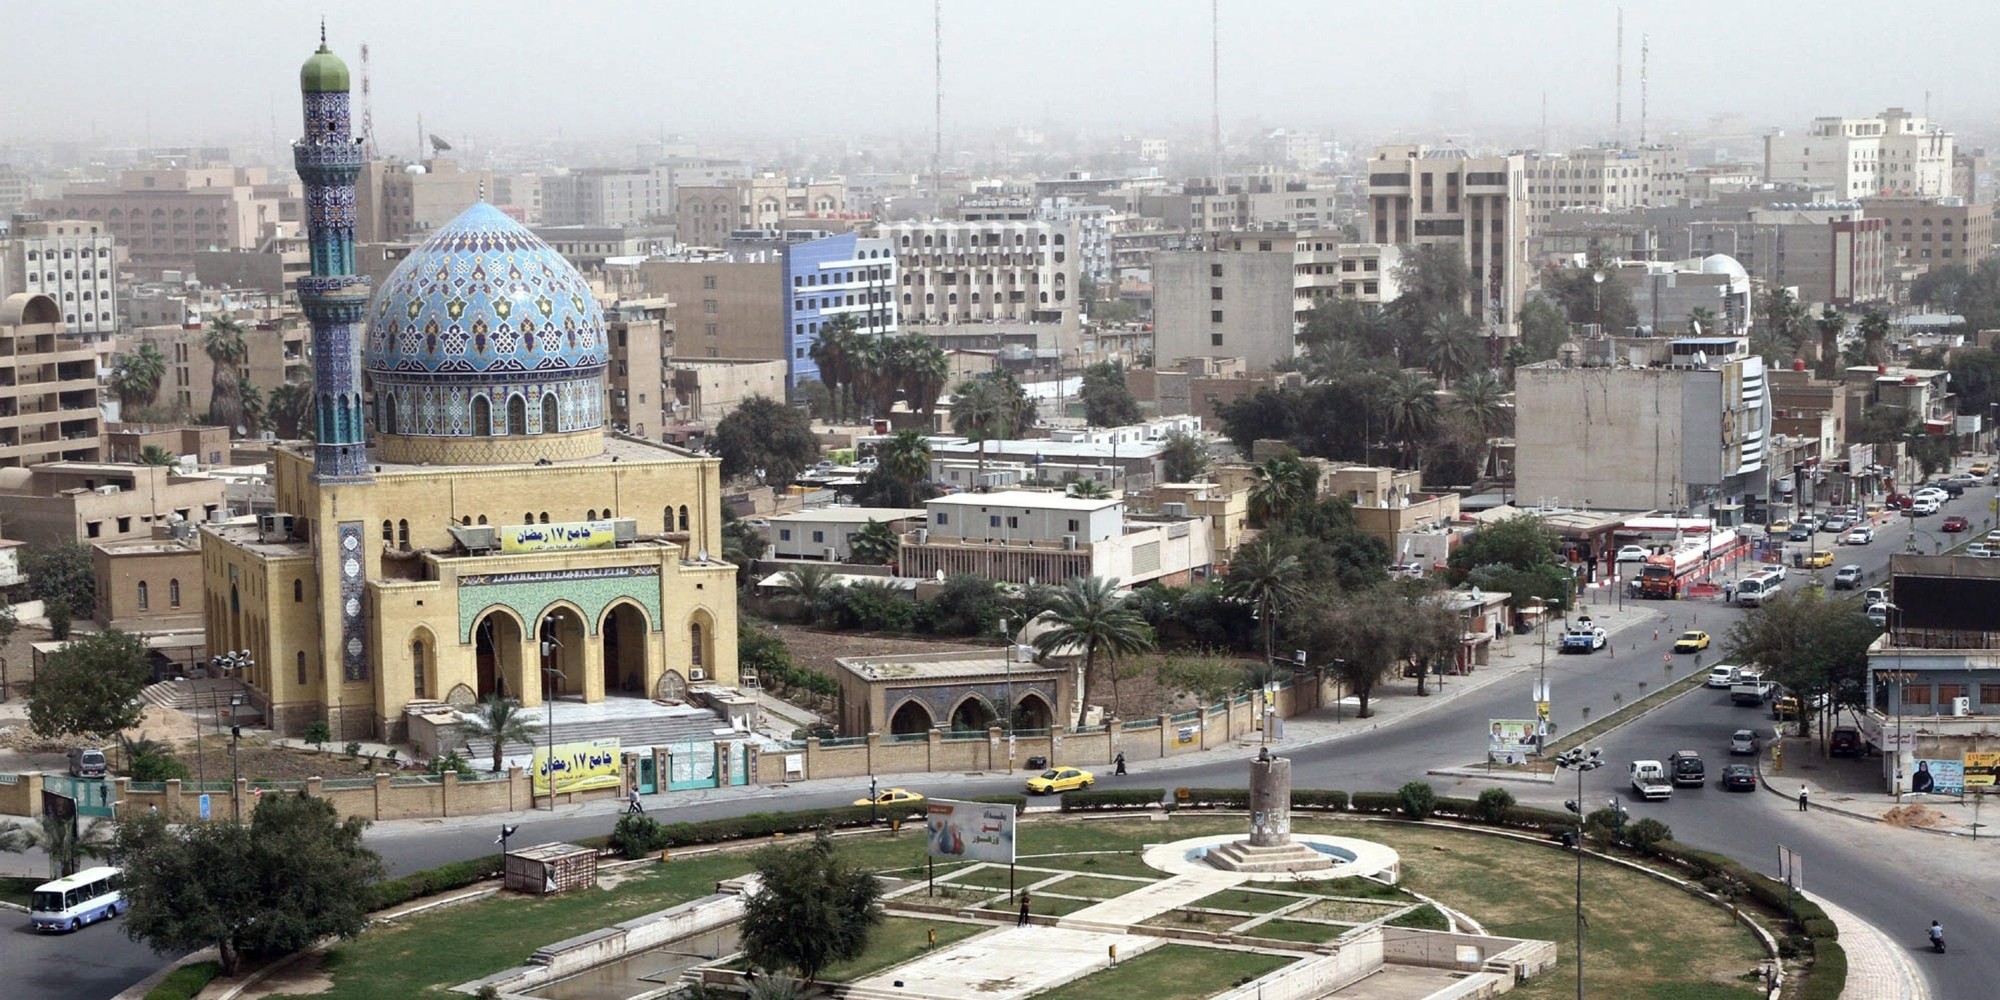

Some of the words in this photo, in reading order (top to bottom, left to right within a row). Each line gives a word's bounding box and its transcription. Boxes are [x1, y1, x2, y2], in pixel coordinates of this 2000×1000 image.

[517, 528, 548, 544] رمضان
[551, 527, 564, 540] ١٧
[567, 526, 591, 541] جامع
[541, 756, 571, 776] رمضان
[573, 752, 586, 770] ١٧
[589, 750, 612, 770] جامع
